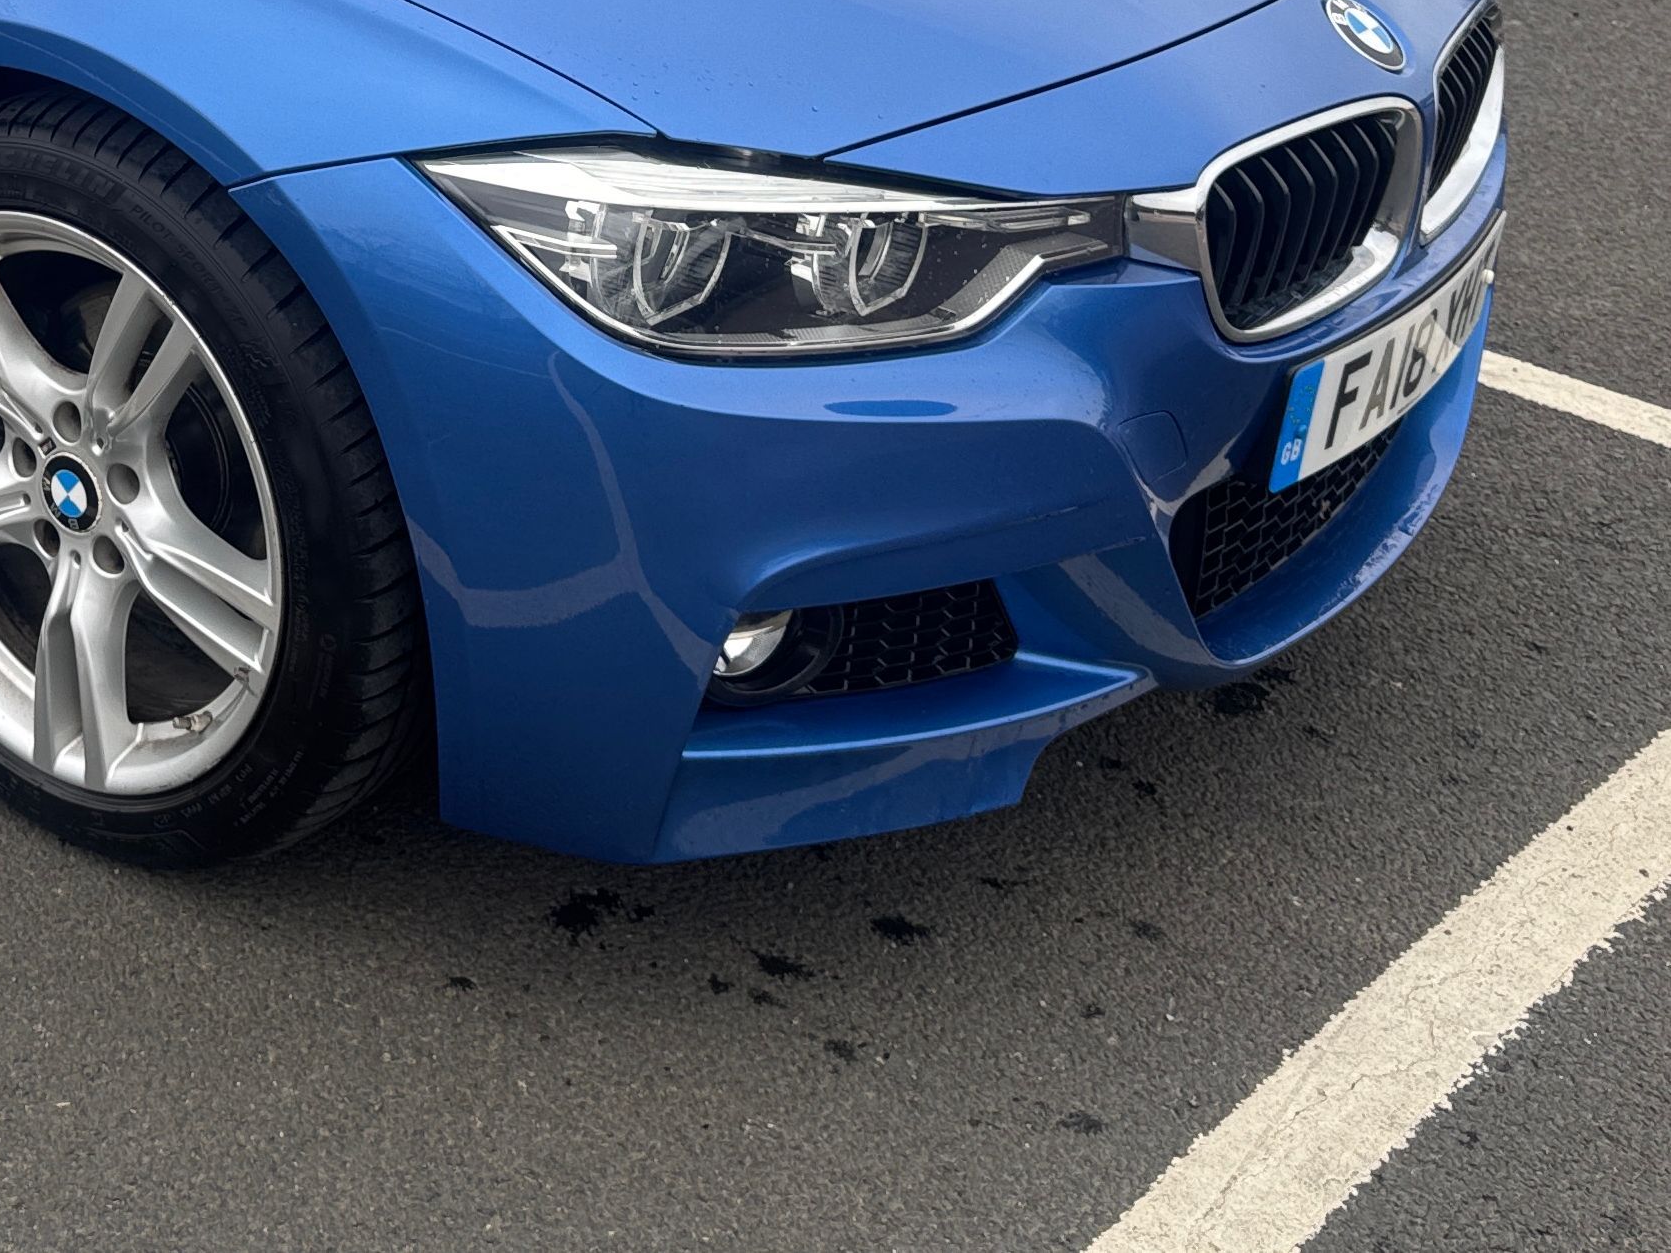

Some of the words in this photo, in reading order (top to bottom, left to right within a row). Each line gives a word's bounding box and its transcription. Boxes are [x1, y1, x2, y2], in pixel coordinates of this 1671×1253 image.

[131, 203, 173, 240] PILOT
[176, 243, 223, 295] SPORT
[1280, 438, 1303, 466] GB
